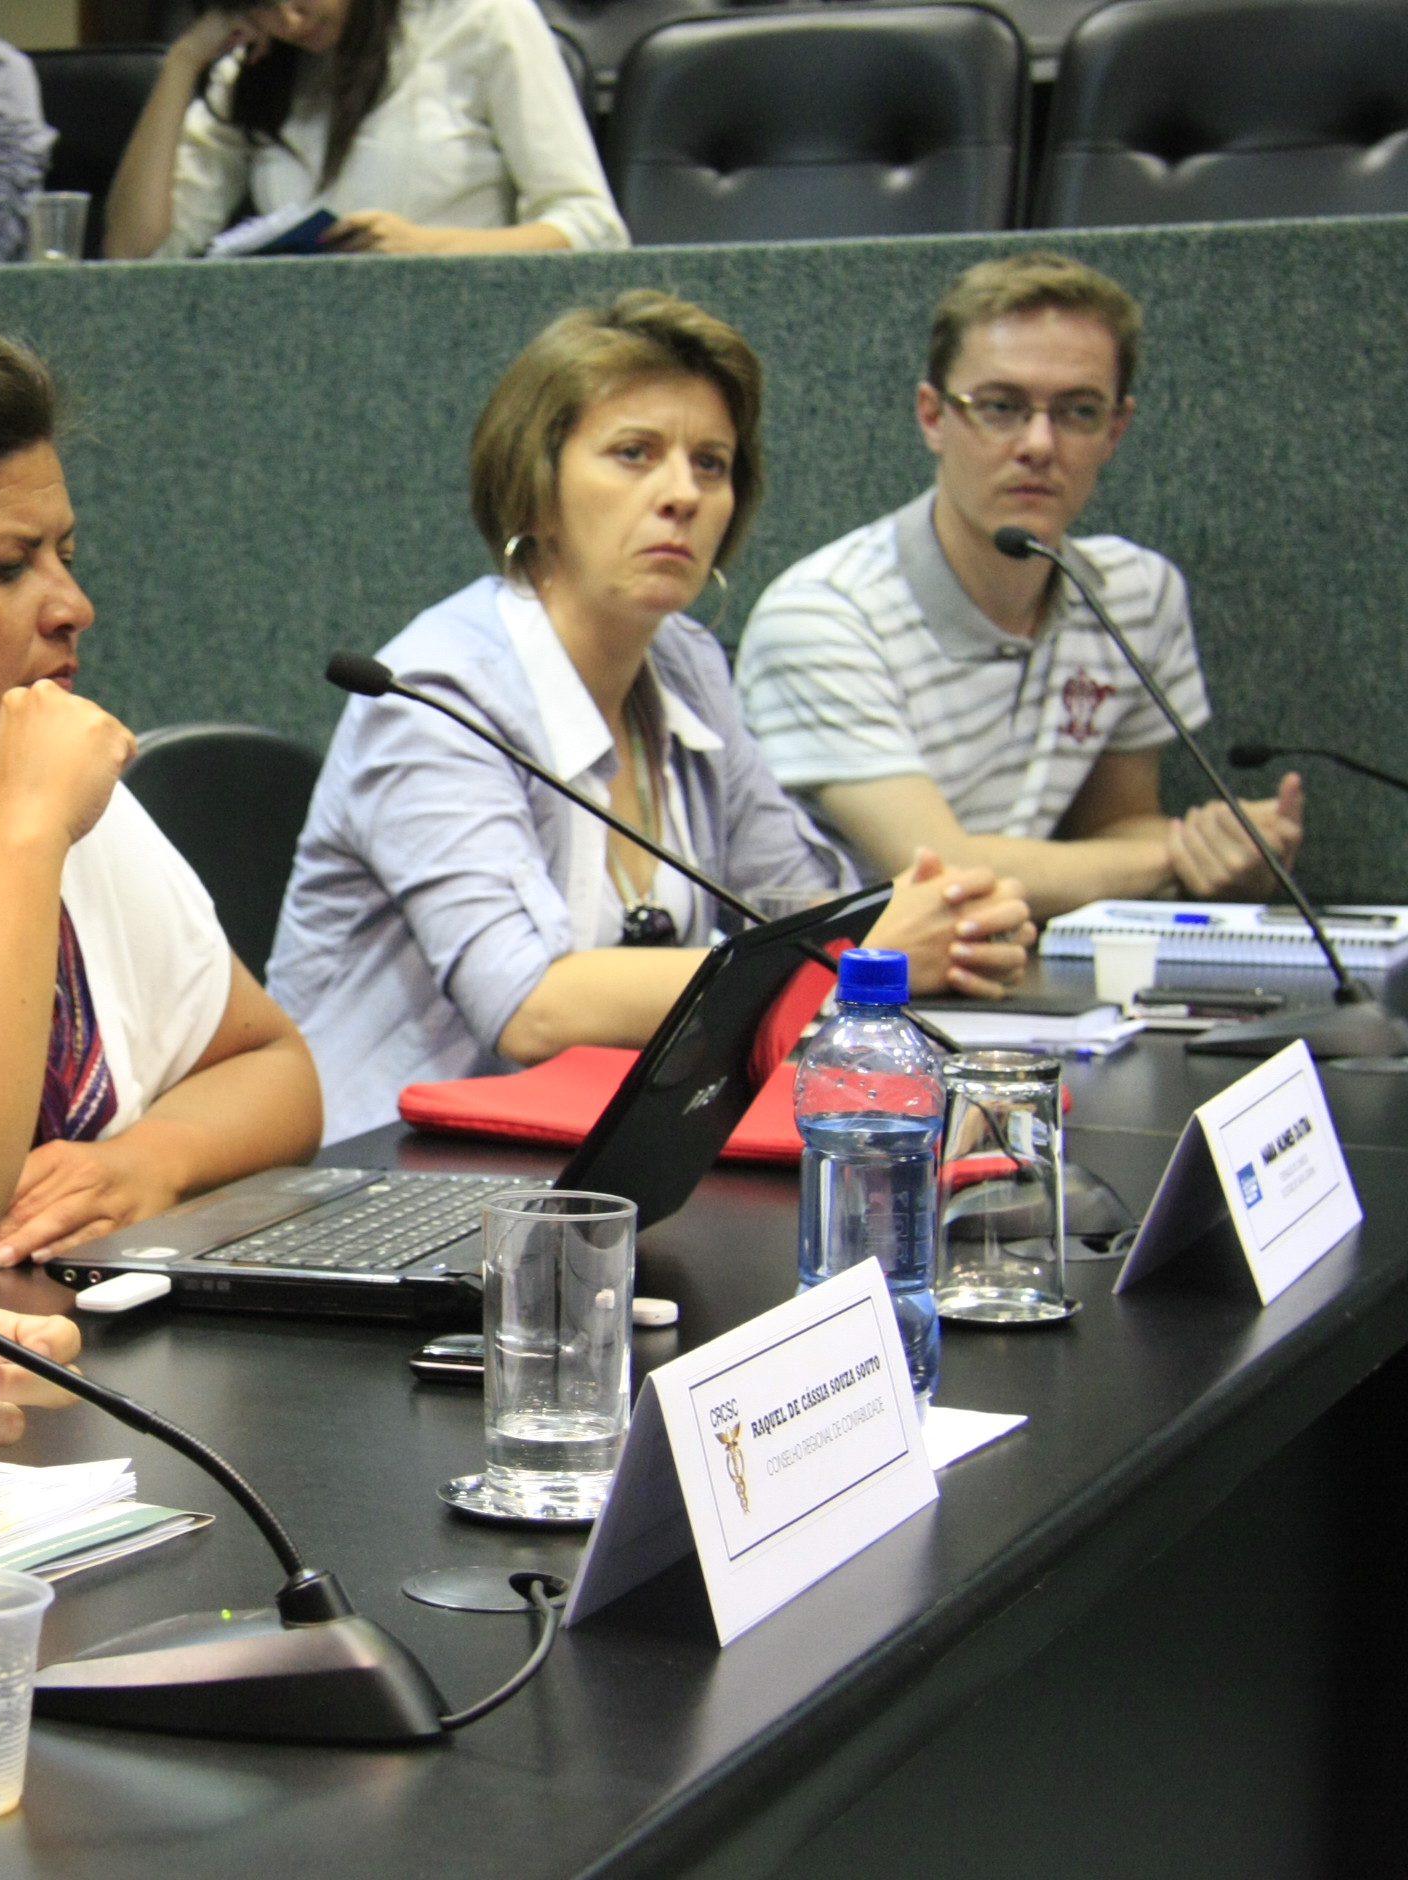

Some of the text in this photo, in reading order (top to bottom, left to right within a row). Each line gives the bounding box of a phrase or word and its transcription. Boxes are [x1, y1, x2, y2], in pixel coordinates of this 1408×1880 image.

[710, 1398, 739, 1428] CRCSC
[750, 1354, 881, 1439] RAQUEL DE CÁSSIA SOUZA SOUTO
[766, 1396, 885, 1477] CONSELHO REGIONAL DE CONTABILIDADE
